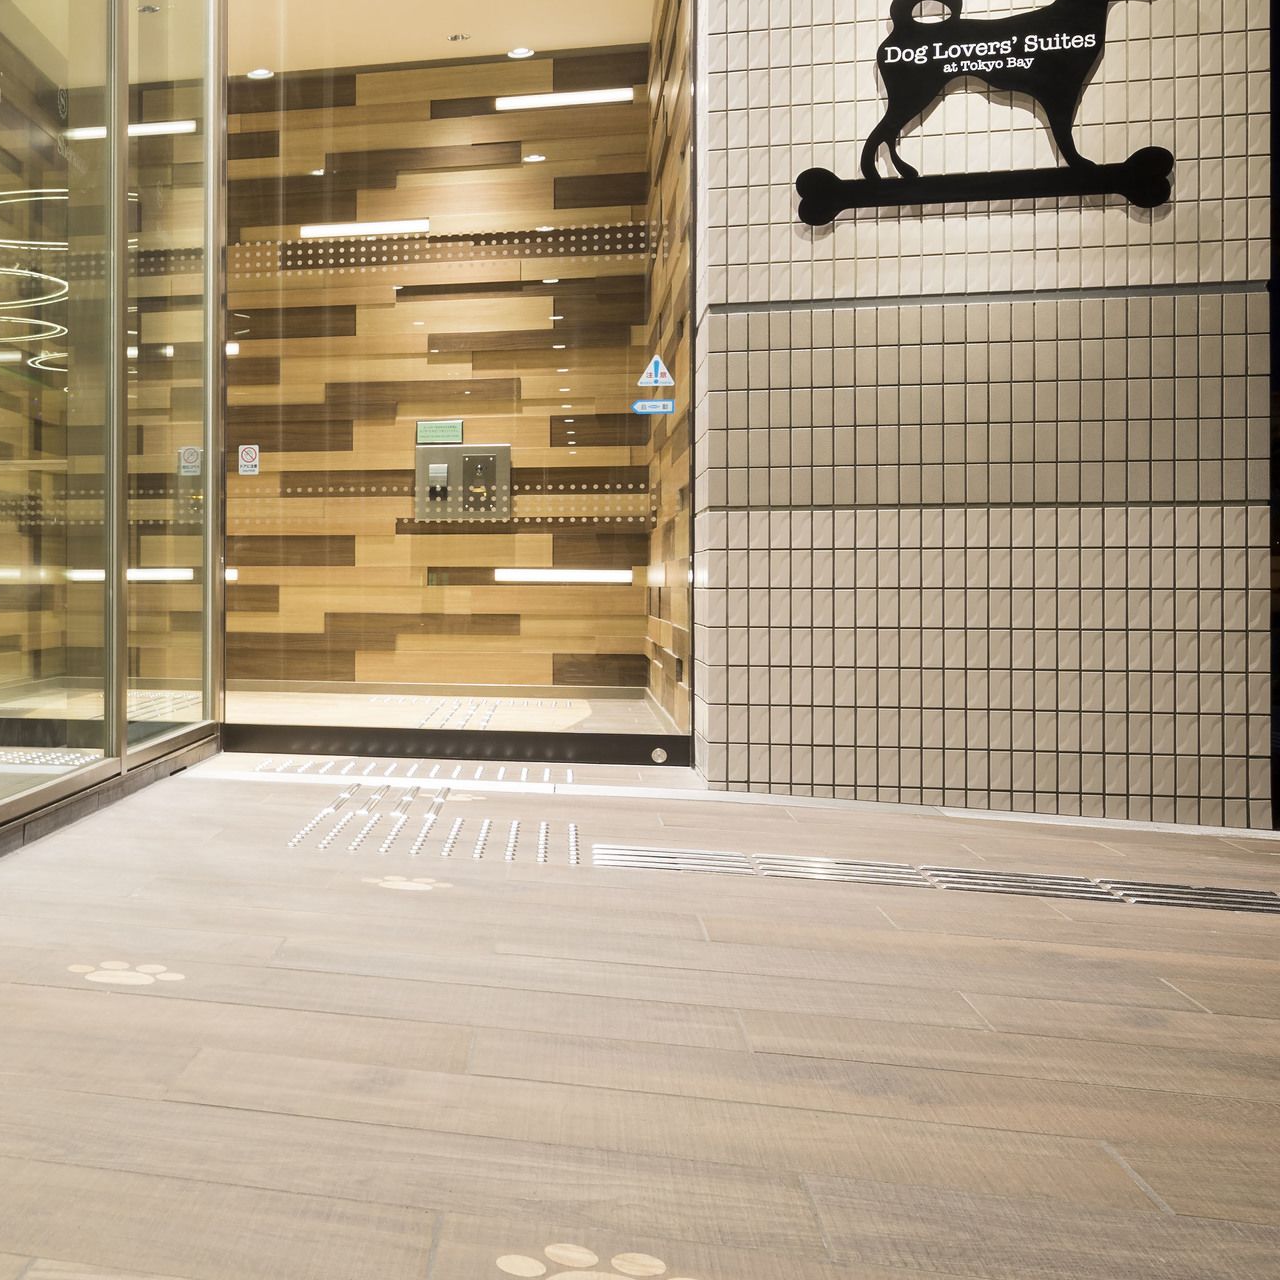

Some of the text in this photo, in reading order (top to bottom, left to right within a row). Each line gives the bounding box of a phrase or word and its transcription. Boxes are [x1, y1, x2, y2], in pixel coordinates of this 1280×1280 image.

[884, 33, 1096, 64] Dog Lovers' Suites
[943, 57, 1034, 73] at Tokyo Bay
